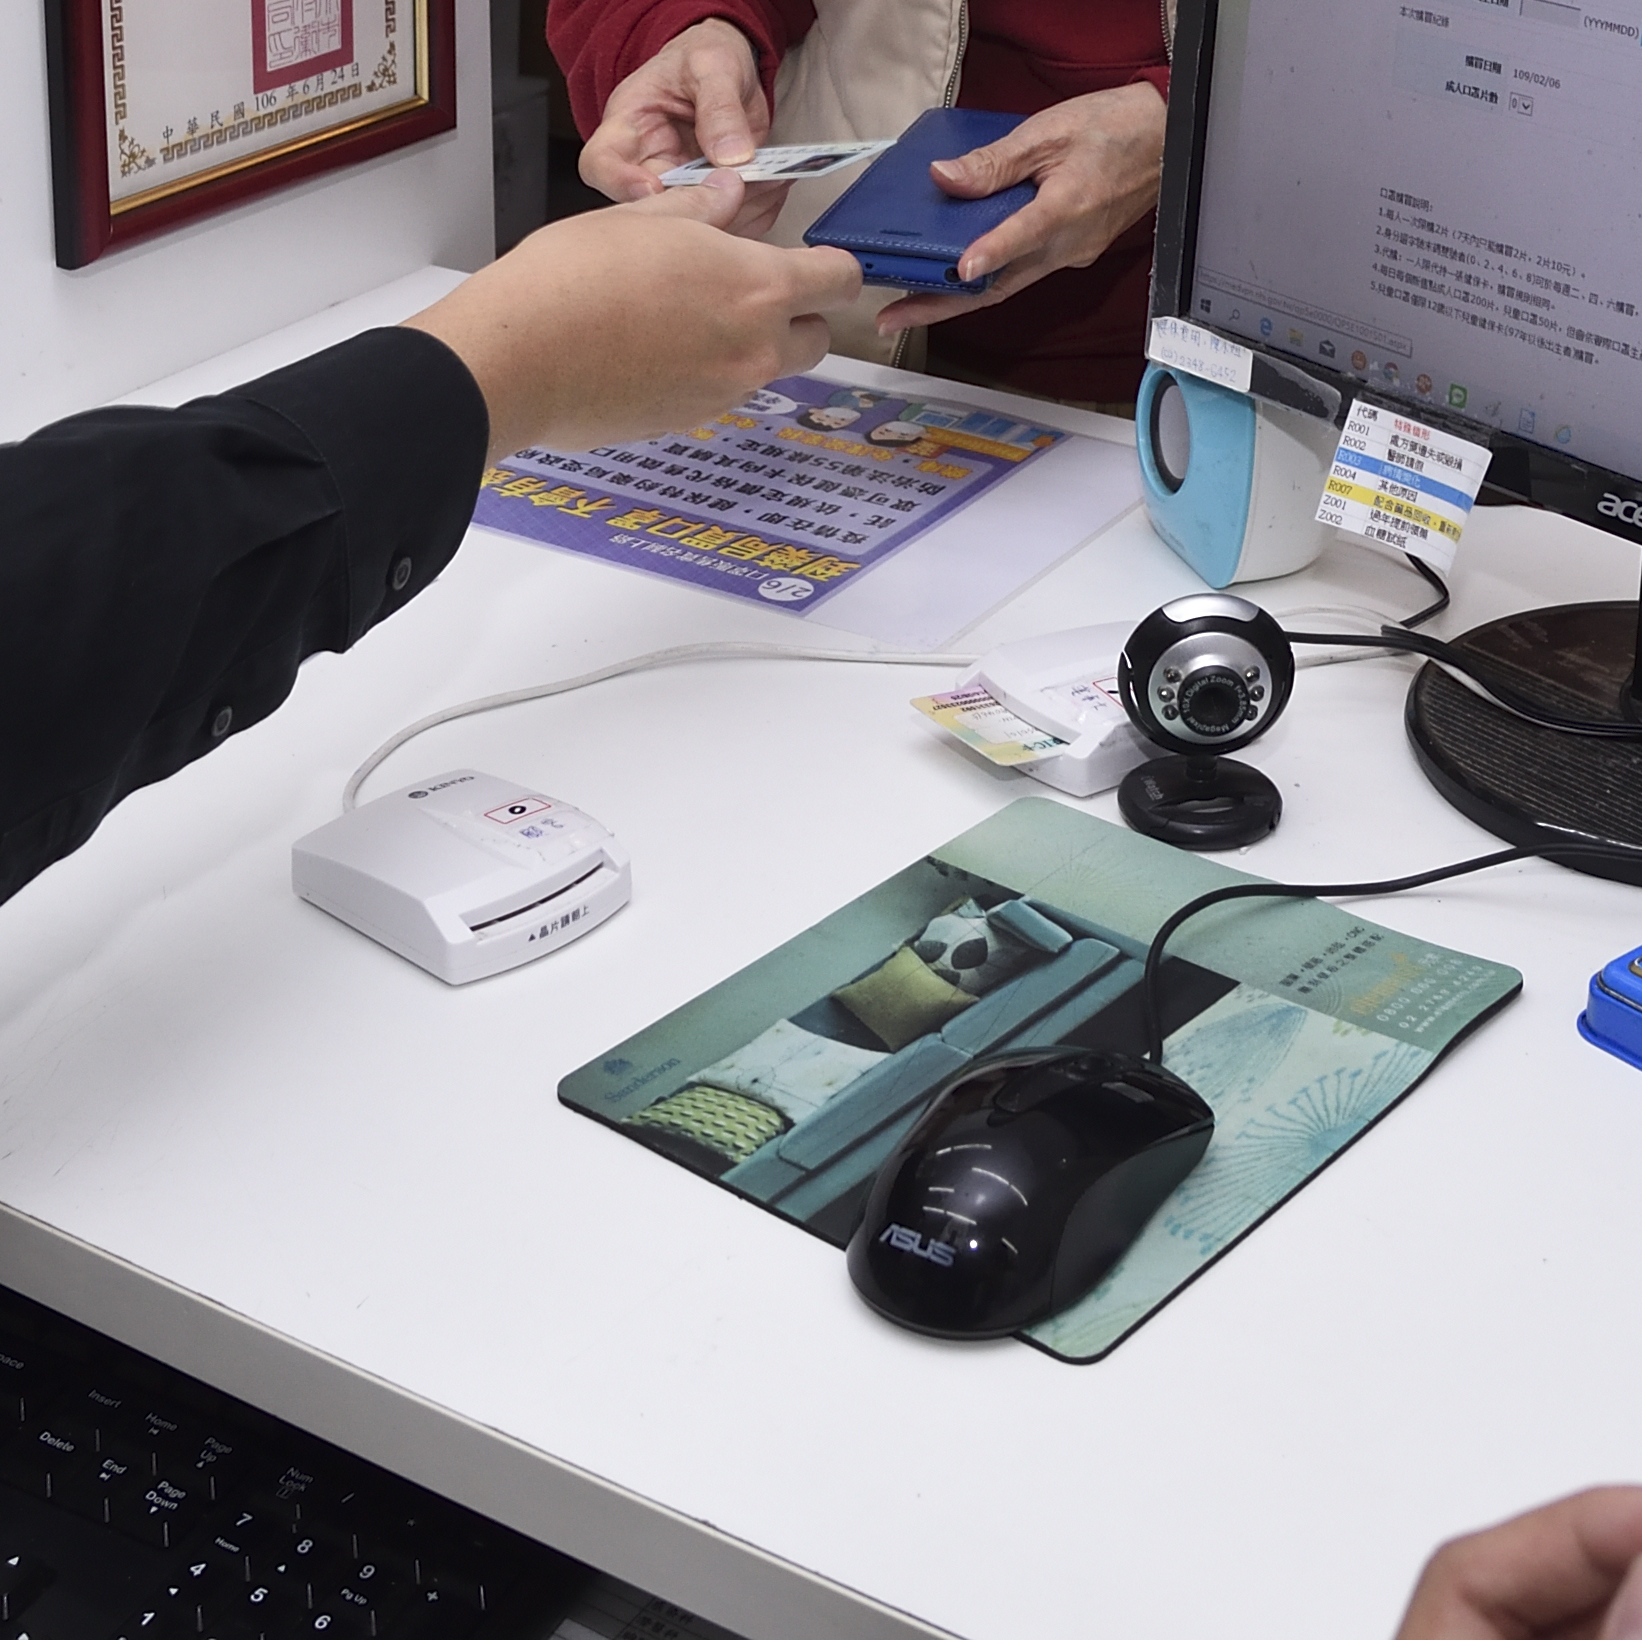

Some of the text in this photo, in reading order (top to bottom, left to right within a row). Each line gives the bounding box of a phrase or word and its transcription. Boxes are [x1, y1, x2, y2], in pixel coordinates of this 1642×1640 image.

[1465, 55, 1560, 89] 購買日期 109/02/06
[1357, 407, 1378, 421] 代碼
[1347, 421, 1370, 435] R001
[1343, 436, 1366, 451] R002
[1338, 451, 1362, 466] R003
[1328, 480, 1352, 494] R007
[1333, 465, 1418, 502] R004 其他原因
[1323, 495, 1346, 510] Z001
[1319, 509, 1342, 525] Z002
[762, 579, 811, 599] 2/6
[1210, 675, 1234, 687] Zoom
[879, 1223, 956, 1267] ASUS
[39, 1431, 76, 1452] Delete
